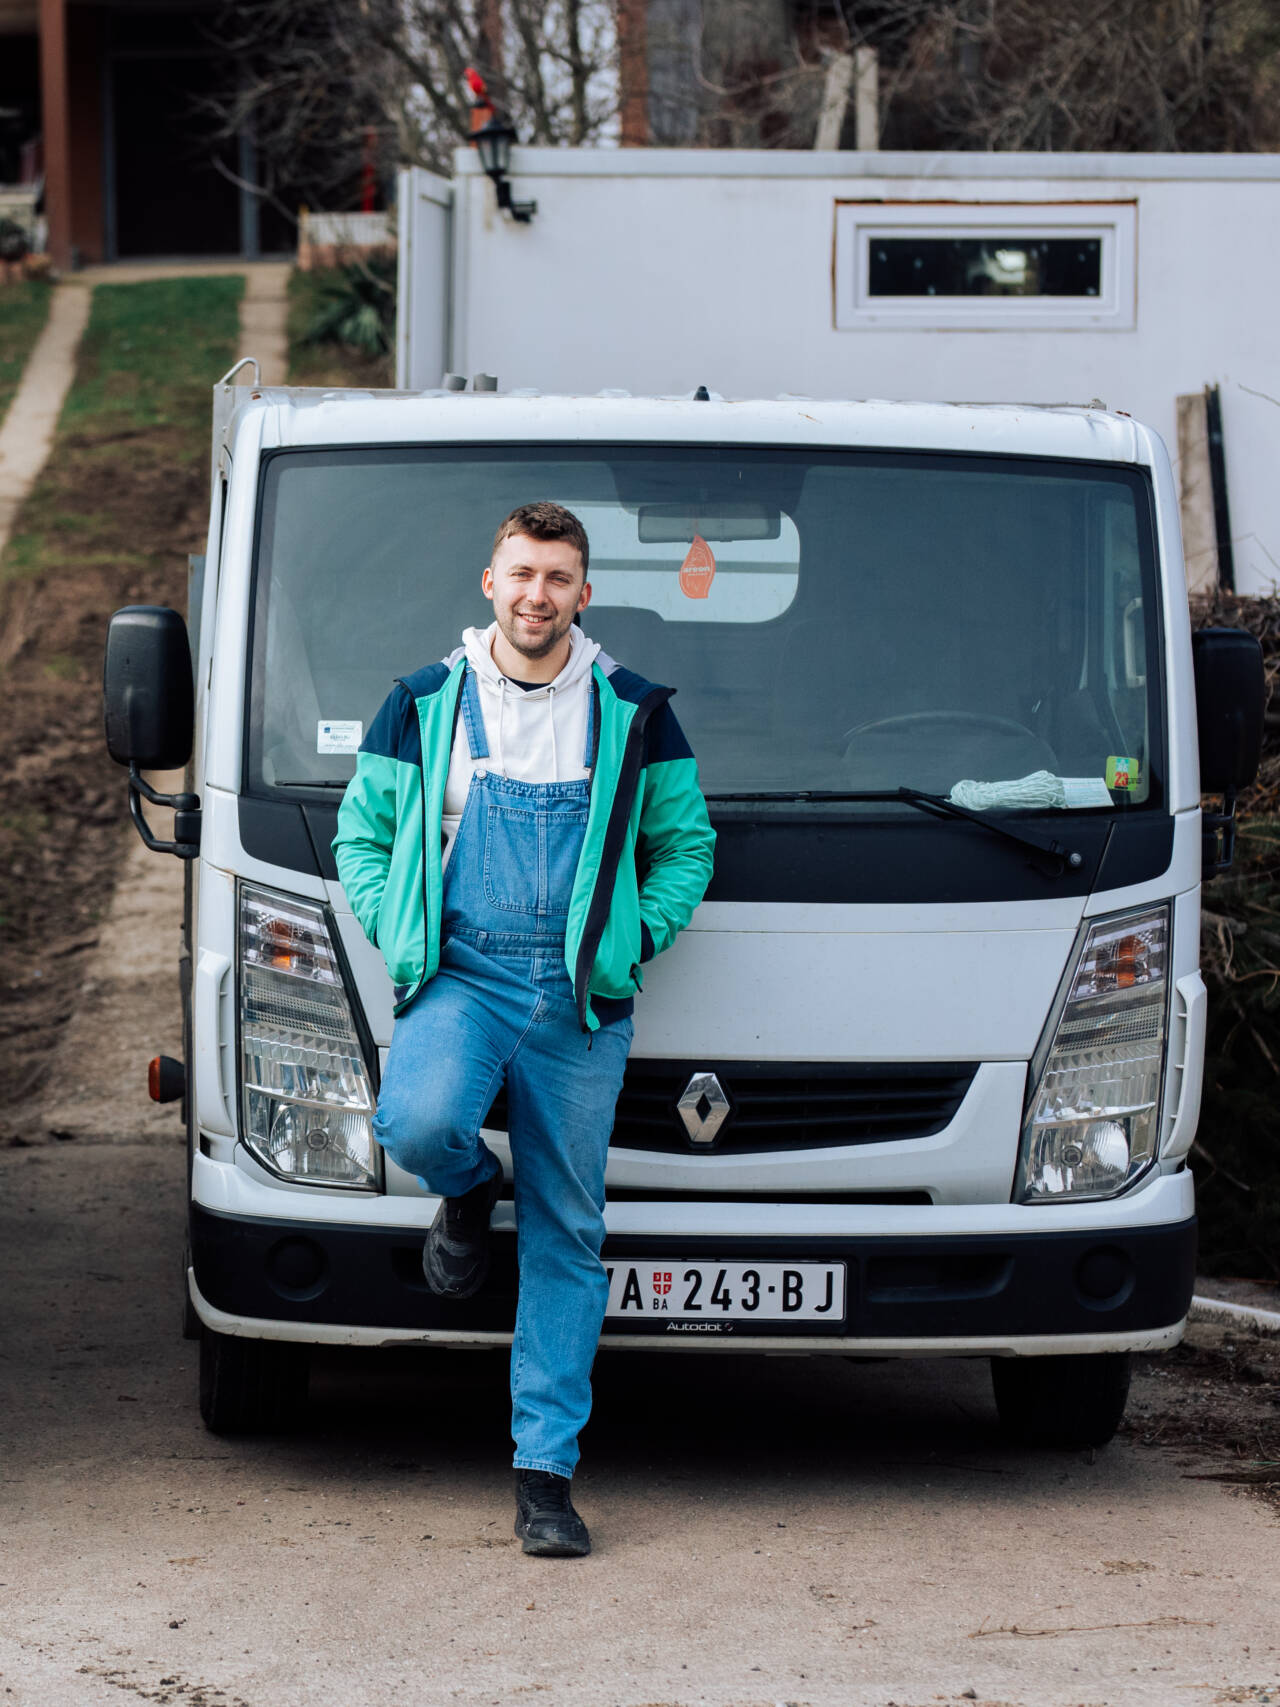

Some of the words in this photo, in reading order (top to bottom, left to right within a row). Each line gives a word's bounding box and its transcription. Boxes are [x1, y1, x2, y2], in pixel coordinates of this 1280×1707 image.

[1114, 771, 1129, 787] 23
[653, 1298, 668, 1310] BA
[666, 1321, 722, 1332] Autodot
